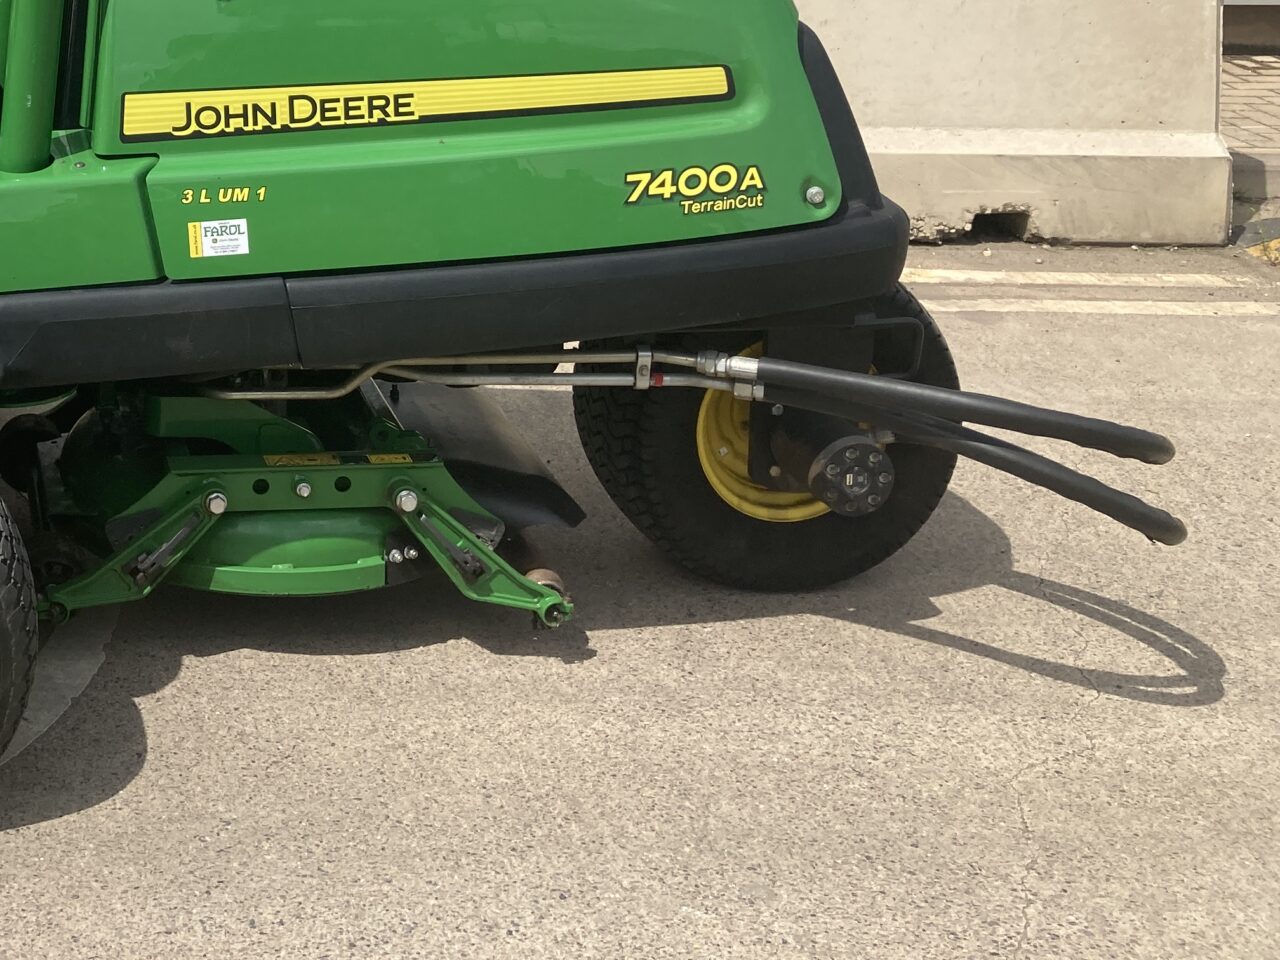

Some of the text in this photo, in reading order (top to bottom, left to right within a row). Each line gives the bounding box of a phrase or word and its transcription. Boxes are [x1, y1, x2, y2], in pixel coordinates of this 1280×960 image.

[171, 93, 415, 132] JOHN DEERE
[625, 163, 765, 204] 7400A
[181, 186, 267, 204] 3 L UM 1
[680, 193, 763, 214] TerrainCut
[203, 224, 246, 238] FAROL
